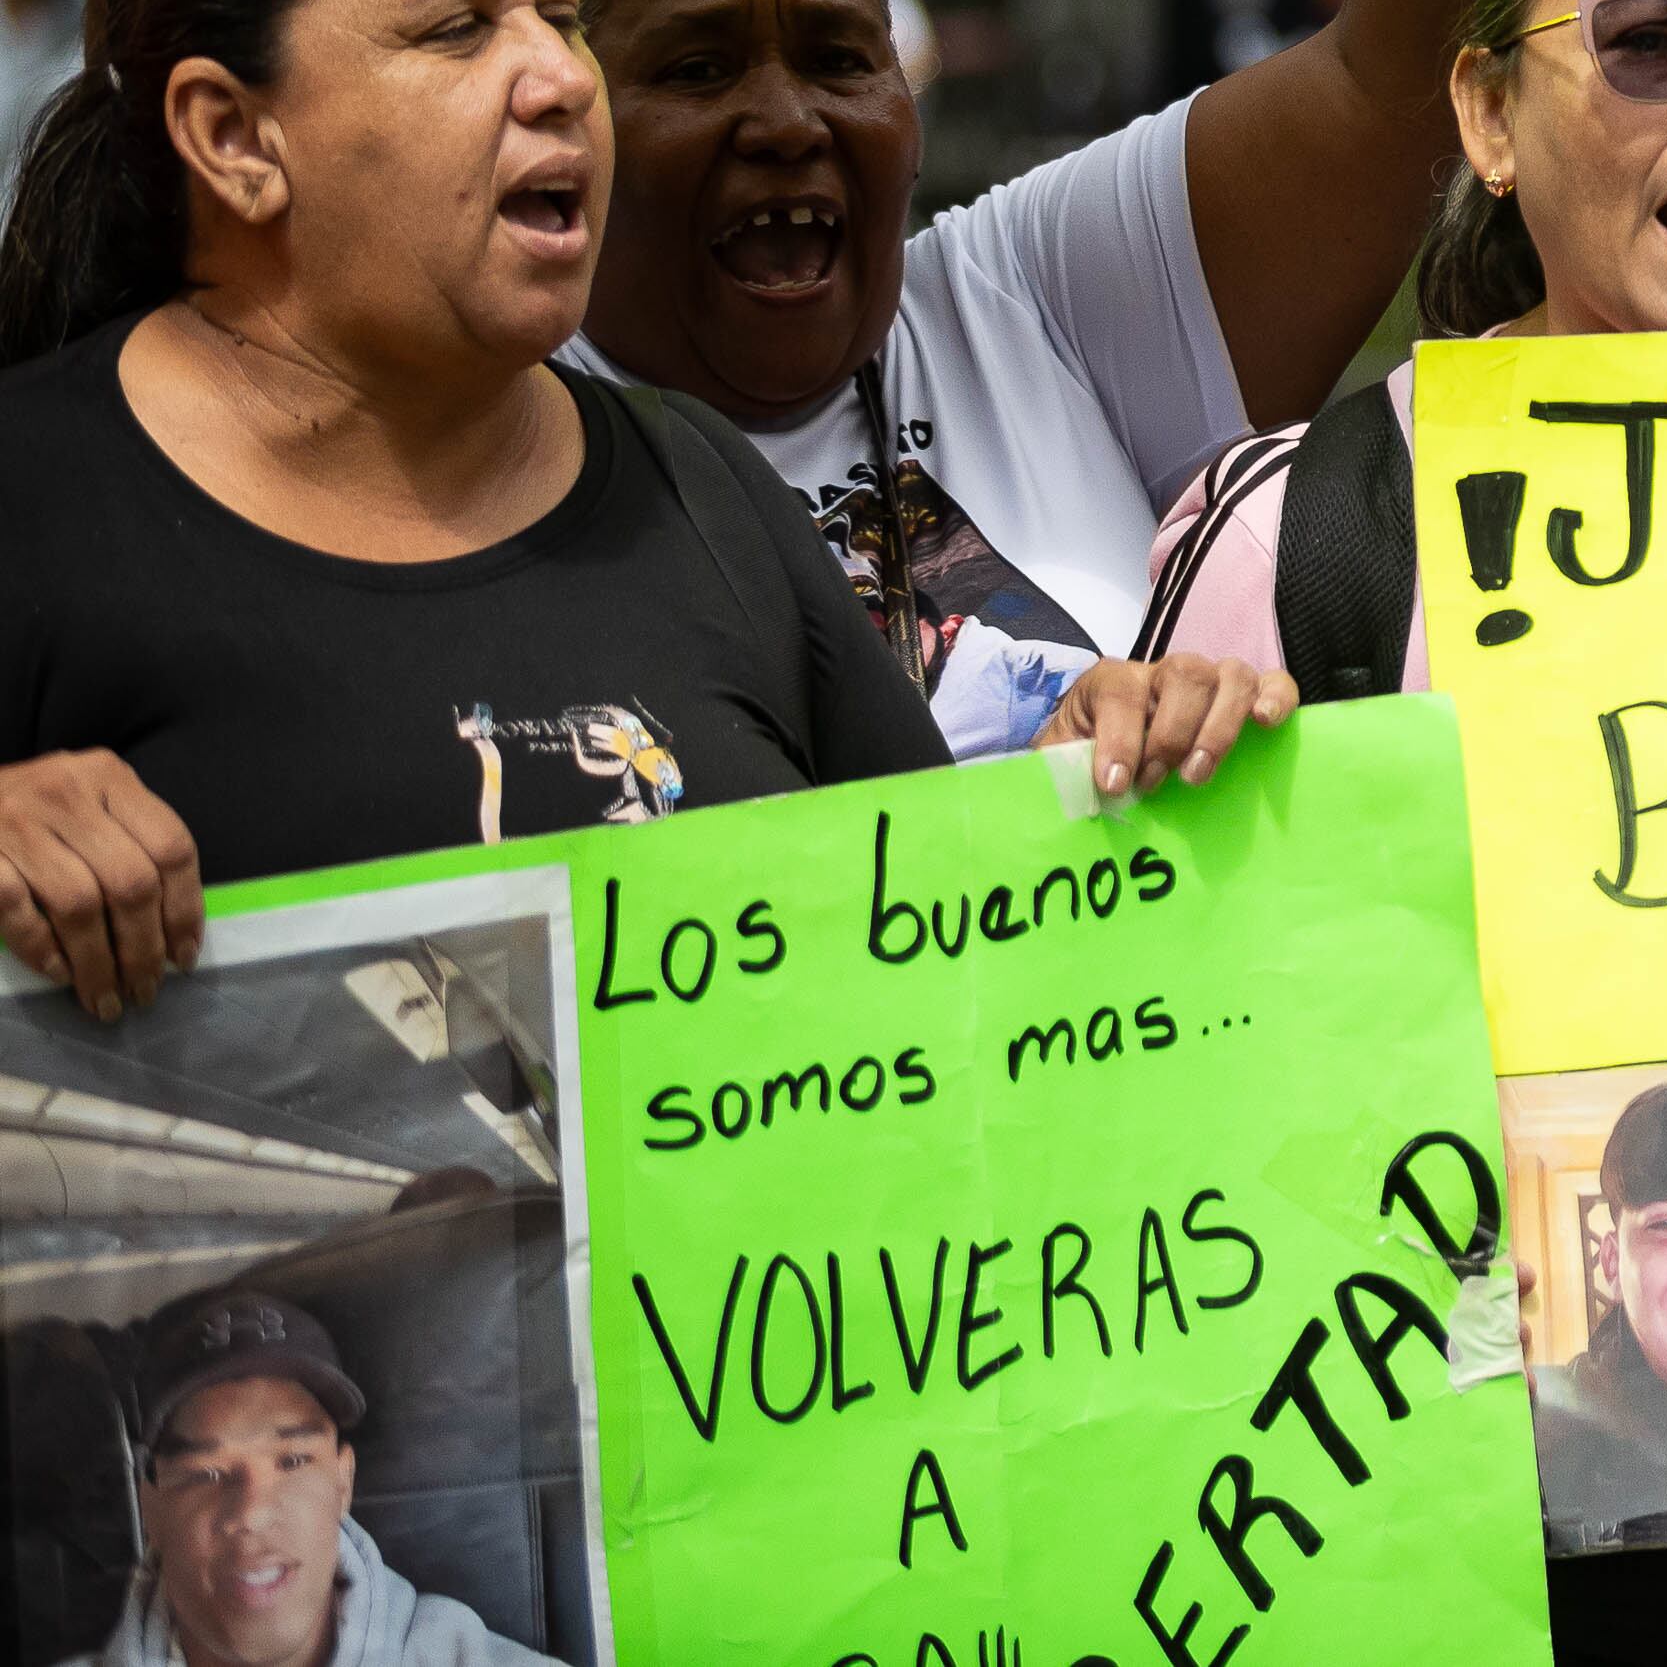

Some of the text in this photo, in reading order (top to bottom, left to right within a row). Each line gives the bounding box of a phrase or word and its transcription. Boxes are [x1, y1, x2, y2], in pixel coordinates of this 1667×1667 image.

[594, 810, 1176, 1010] Los buenos
[644, 1046, 937, 1152] somos
[632, 1187, 1263, 1444] VOLVERAS
[898, 1448, 968, 1571] A
